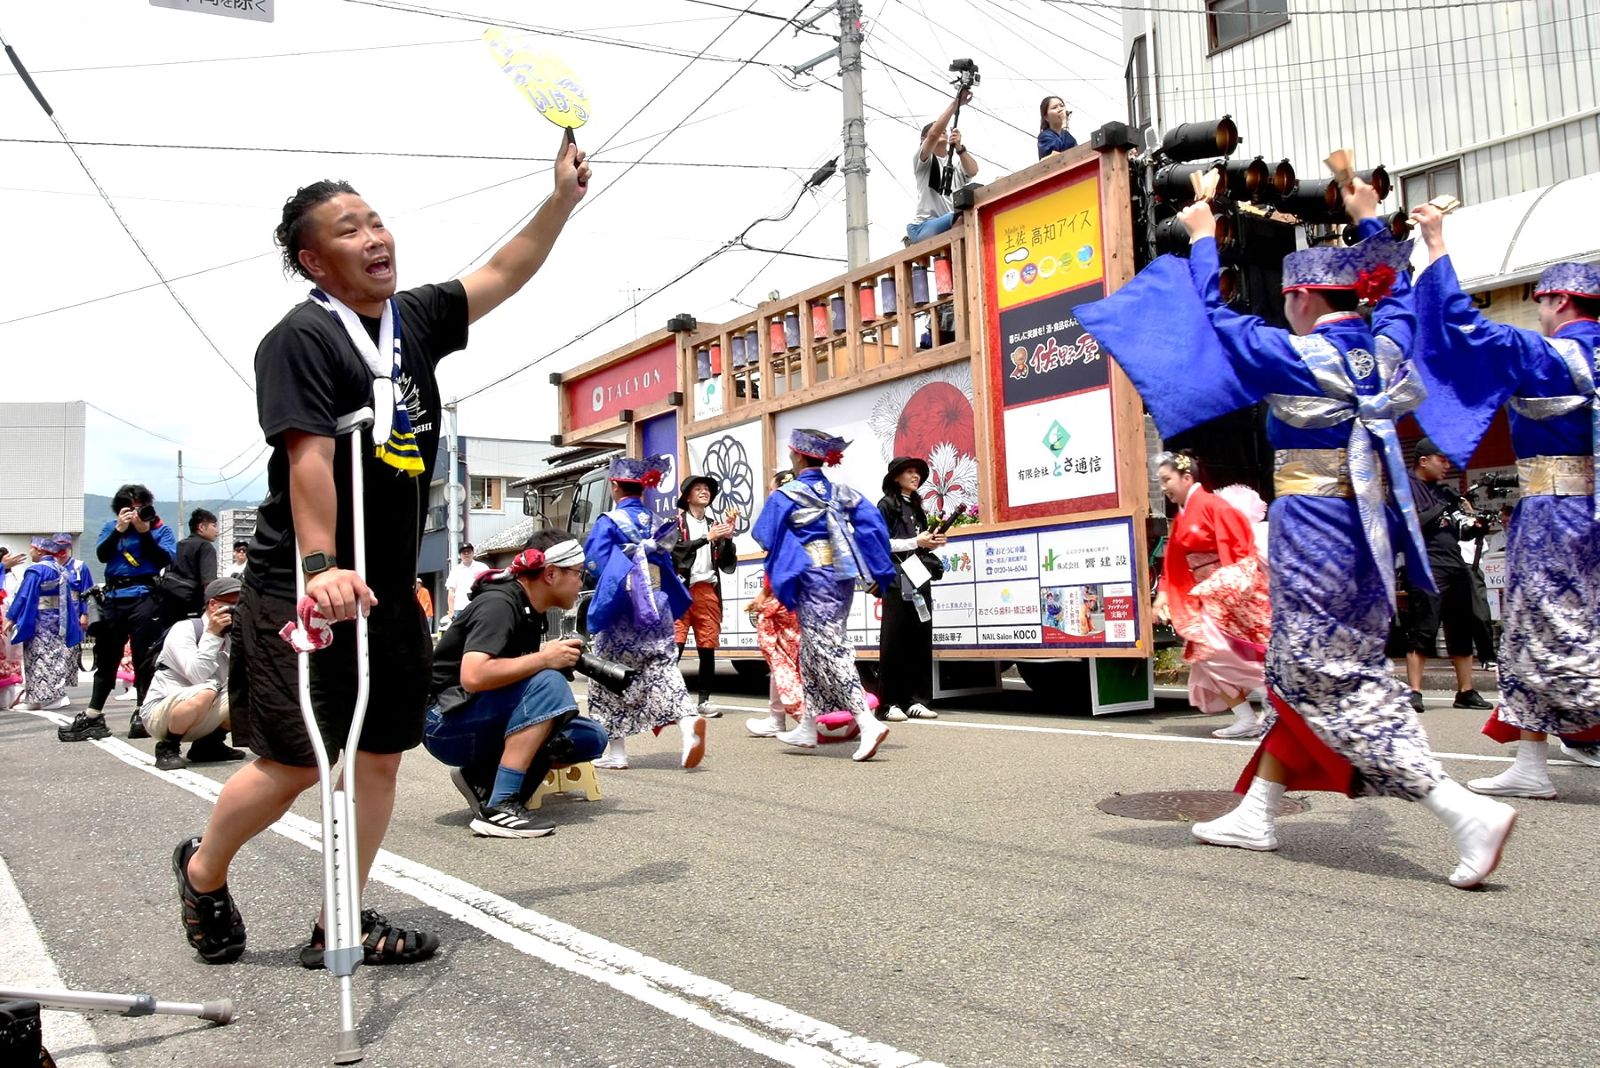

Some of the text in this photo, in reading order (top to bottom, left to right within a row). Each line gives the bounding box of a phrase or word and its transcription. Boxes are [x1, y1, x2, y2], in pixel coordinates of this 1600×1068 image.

[1004, 209, 1092, 251] 土佐 高知アイス
[607, 368, 660, 402] TACYON
[1018, 456, 1102, 481] 有限会社 とさ通信
[982, 633, 996, 641] NAIL
[997, 632, 1012, 640] Salon
[1013, 630, 1037, 640] KOCO
